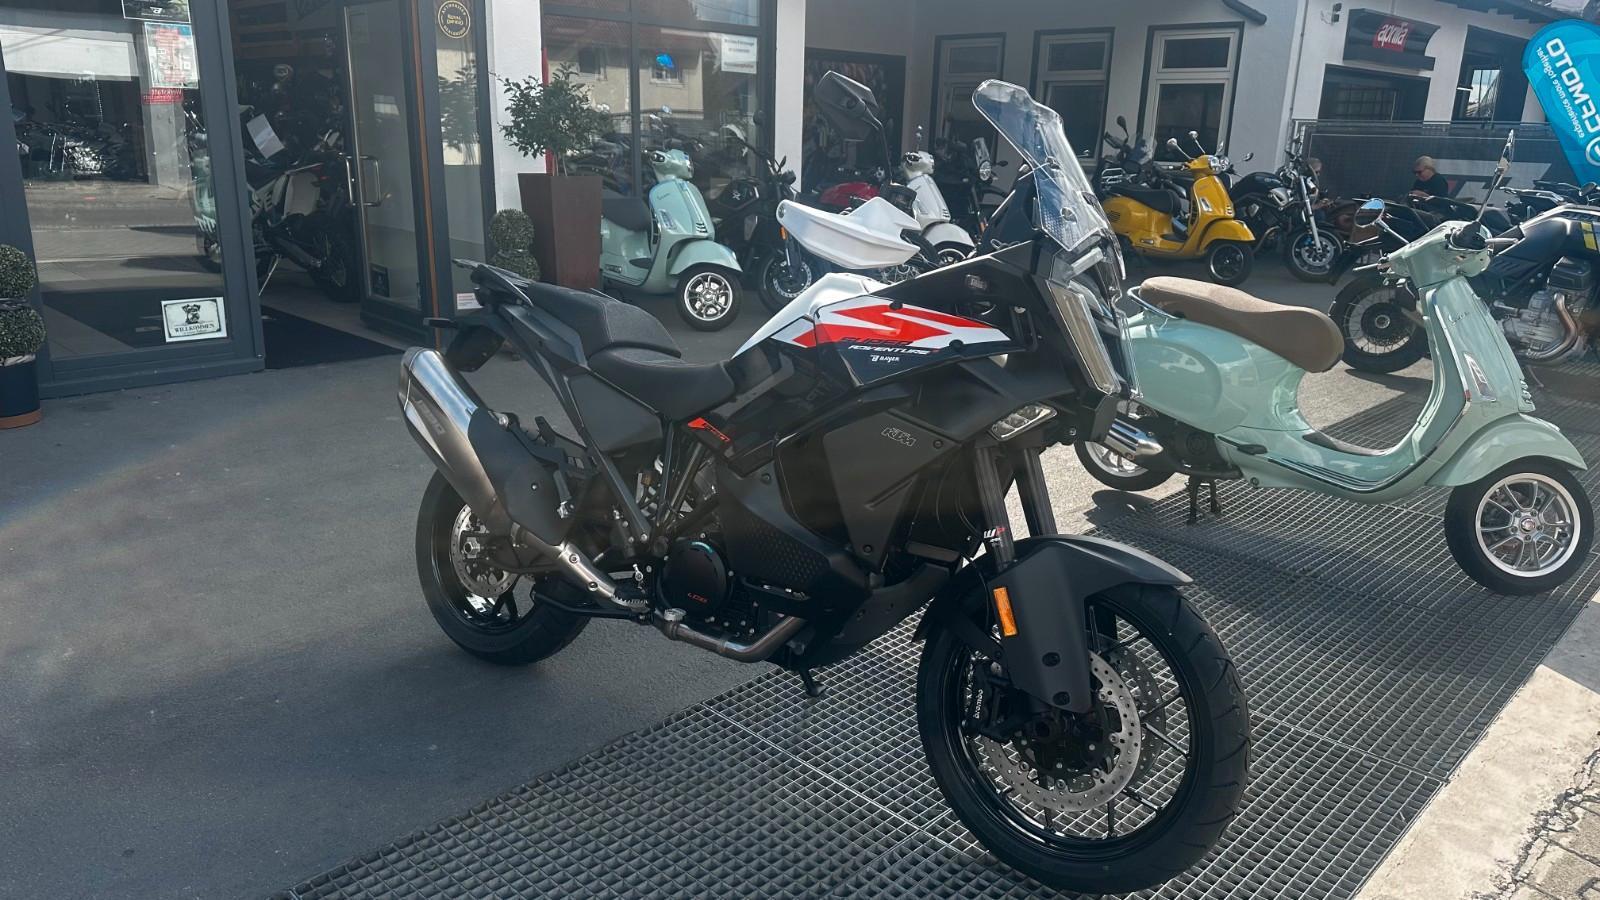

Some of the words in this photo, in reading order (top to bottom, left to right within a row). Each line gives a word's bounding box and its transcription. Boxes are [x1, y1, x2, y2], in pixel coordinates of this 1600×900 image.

[848, 344, 931, 355] ADVENTURE
[881, 427, 917, 447] KTM
[973, 689, 984, 719] brembo
